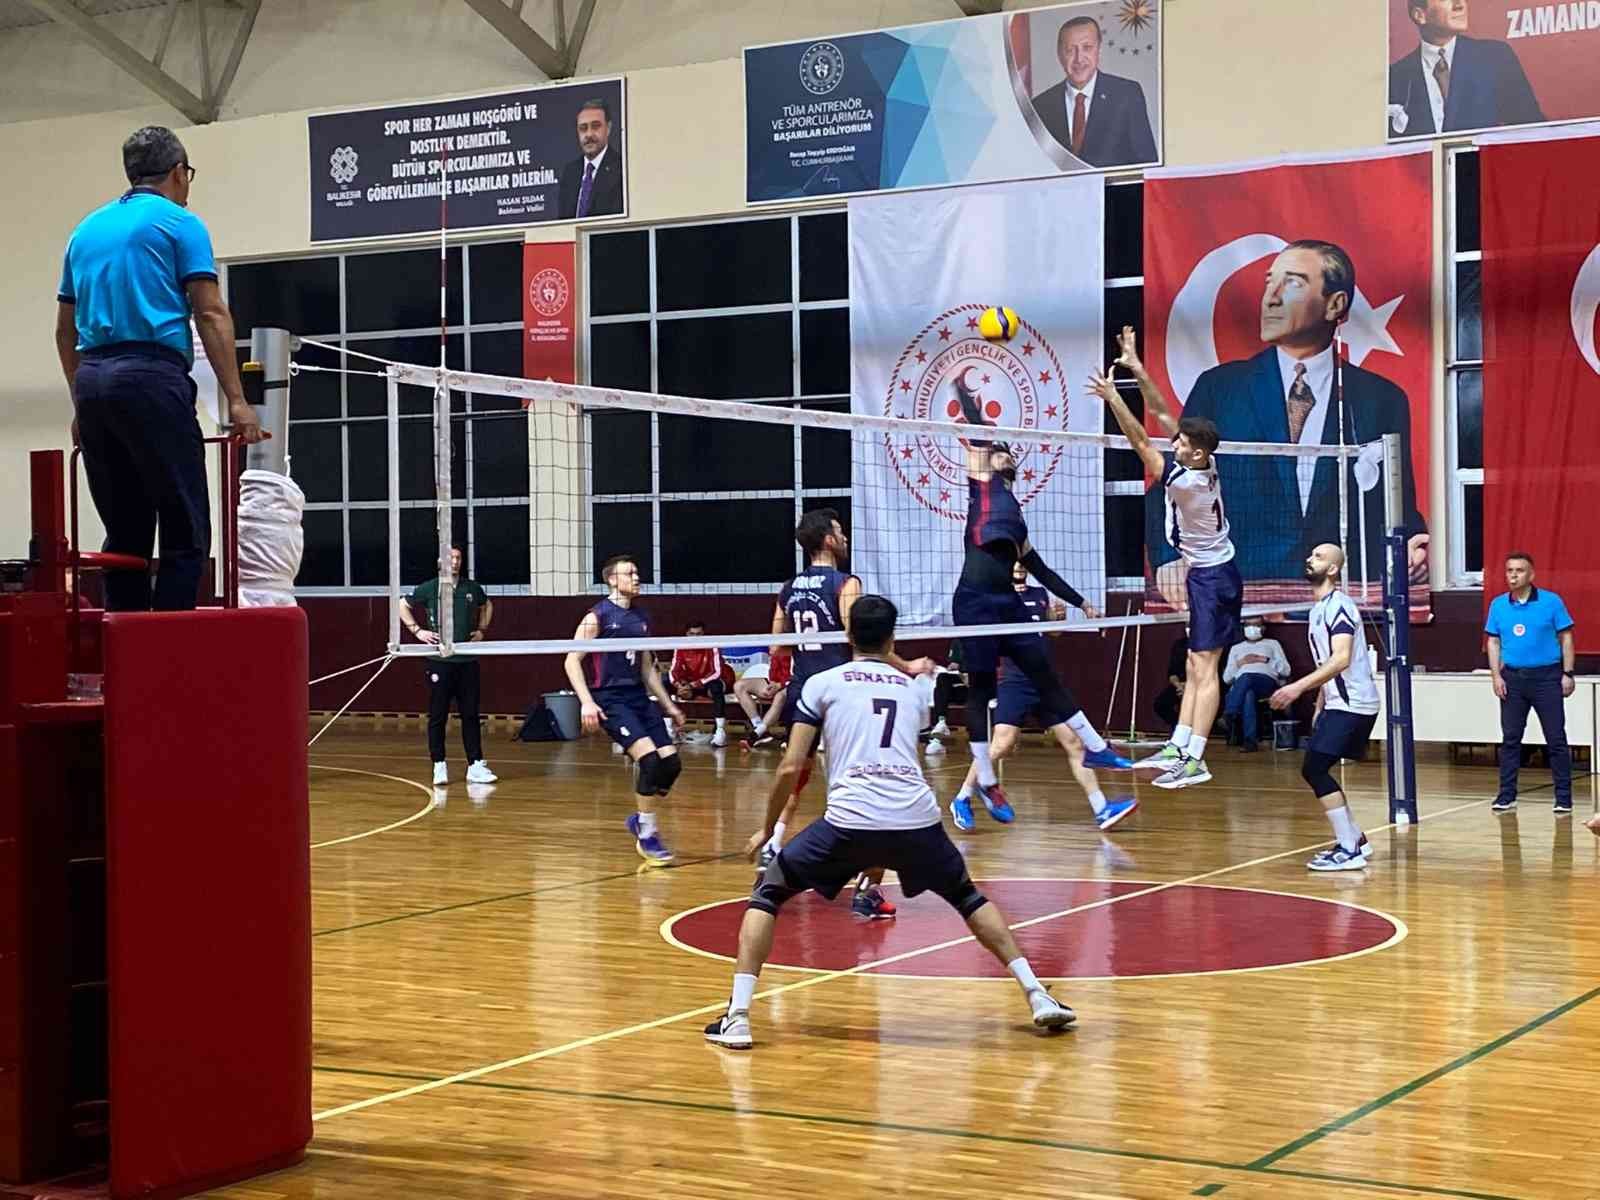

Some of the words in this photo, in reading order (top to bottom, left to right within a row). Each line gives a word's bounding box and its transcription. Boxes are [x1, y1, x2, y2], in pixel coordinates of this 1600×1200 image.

[384, 121, 410, 136] SPOR
[412, 117, 432, 132] HER
[434, 113, 470, 130] ZAMAN
[472, 102, 522, 128] HOŞGÖRÜ
[524, 104, 537, 120] VE
[771, 119, 785, 130] VE
[786, 109, 874, 129] SPORCULARIMIZA
[783, 104, 805, 117] TÜM
[807, 97, 862, 115] ANTRENÖR
[410, 136, 455, 155] DOSTLUK
[457, 128, 511, 150] DEMEKTİR.
[773, 128, 821, 142] BAŞARILAR
[822, 122, 872, 137] DİLİYORUM
[392, 159, 426, 178] BÜTÜN
[428, 153, 515, 175] SPORCULARIMIZA
[517, 150, 531, 165] VE
[454, 173, 510, 196] BAŞARILAR
[512, 165, 558, 188] DİLERİM.
[957, 342, 1007, 365] GENÇLİK
[1007, 358, 1022, 375] VE
[1016, 377, 1034, 414] SPOR
[792, 610, 823, 652] 12
[872, 697, 898, 749] 7
